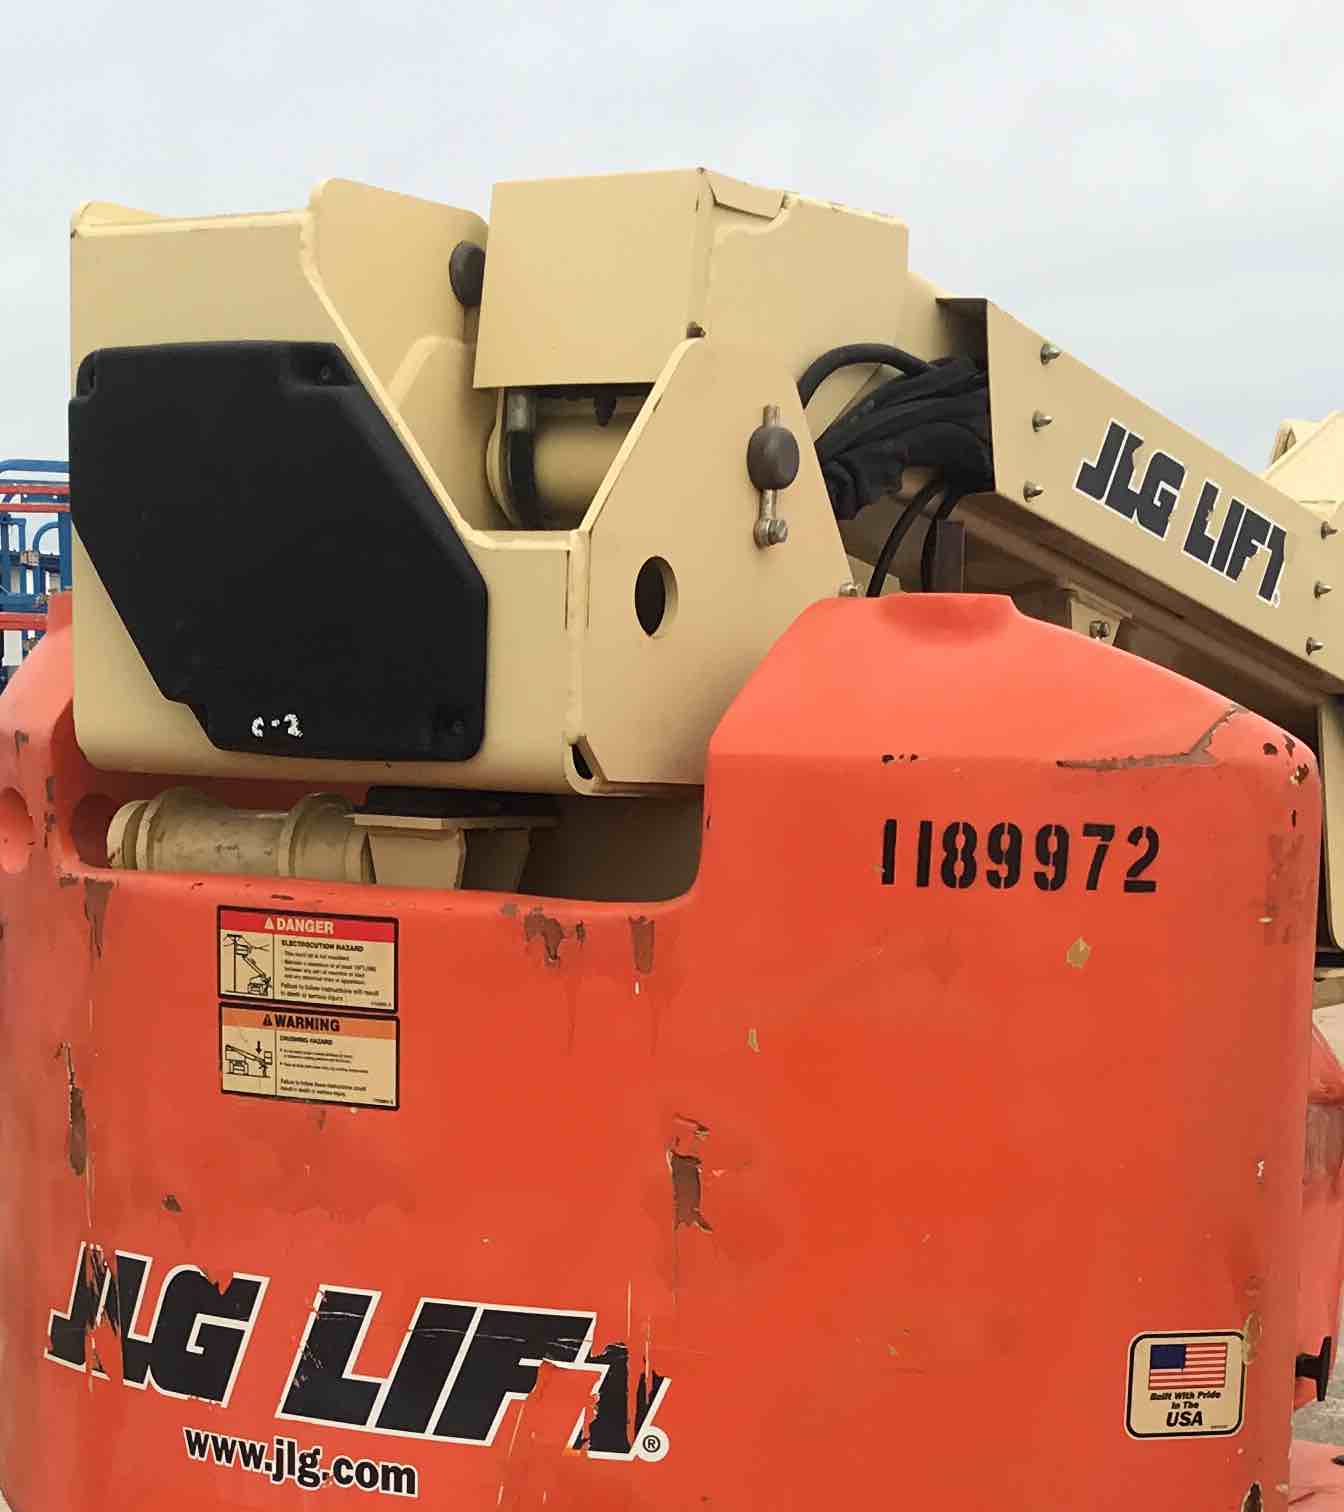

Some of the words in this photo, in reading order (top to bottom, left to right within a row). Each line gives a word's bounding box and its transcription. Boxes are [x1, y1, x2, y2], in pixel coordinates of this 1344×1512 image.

[1072, 418, 1187, 541] JLG
[1180, 478, 1288, 604] LIFT
[881, 818, 1160, 893] 1189972
[276, 918, 335, 935] DANGER
[281, 940, 335, 949] ELECTROCUTION
[336, 944, 364, 953] HAZARD
[275, 1014, 340, 1032] WARNING
[44, 1240, 271, 1409] JLG
[1183, 1400, 1199, 1409] The
[1166, 1411, 1203, 1427] USA
[183, 1427, 418, 1496] www.jlg.com
